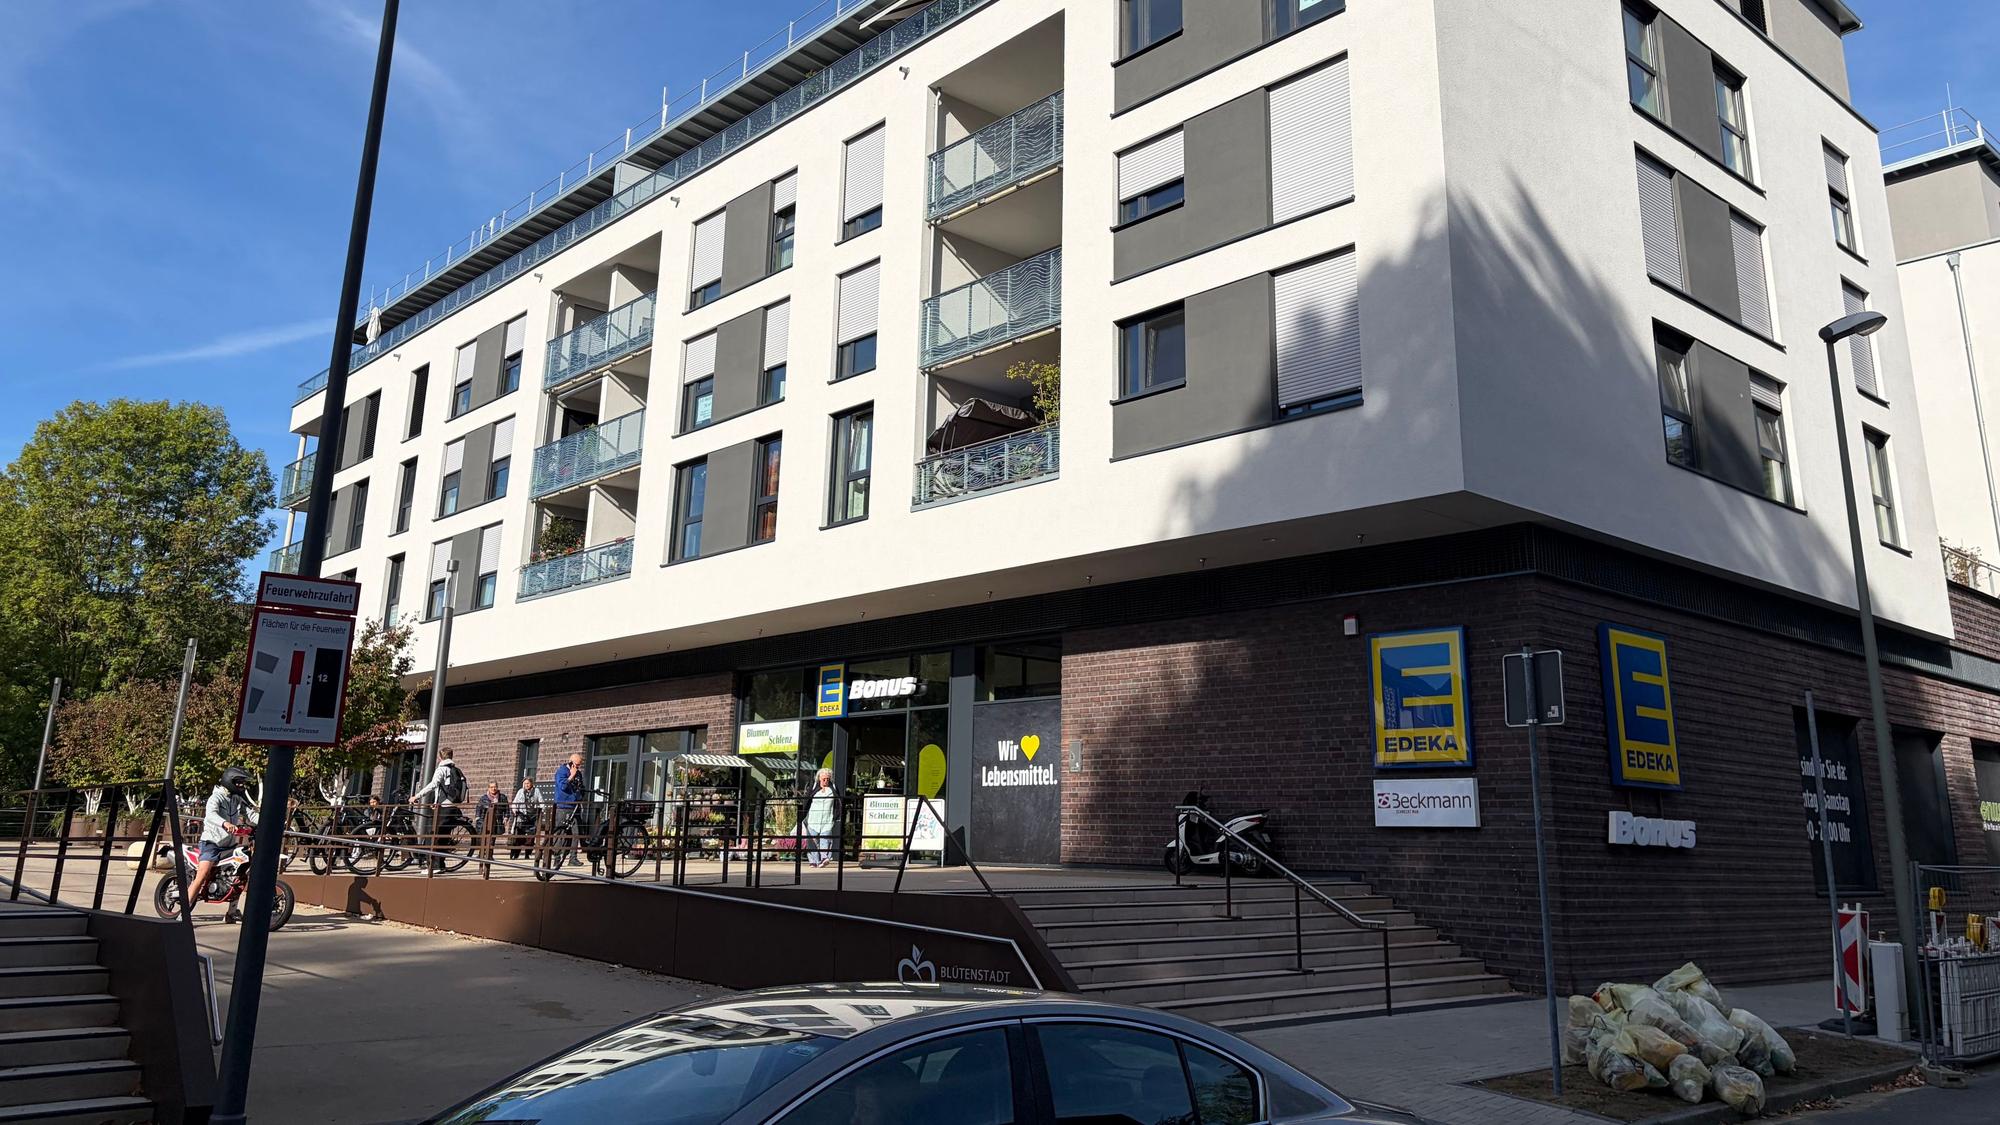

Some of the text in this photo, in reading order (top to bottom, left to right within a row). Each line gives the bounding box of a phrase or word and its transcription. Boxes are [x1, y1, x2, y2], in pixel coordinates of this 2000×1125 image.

[265, 583, 353, 604] Feuerwehrzufahrt
[261, 618, 347, 635] Flächen für die Feuerwehr
[317, 674, 329, 683] 12
[819, 703, 840, 713] EDEKA
[746, 728, 770, 738] Blumen
[768, 734, 793, 745] Schlenz
[997, 740, 1019, 761] Wir
[1384, 734, 1459, 753] EDEKA
[1626, 749, 1675, 773] EDEKA
[1825, 759, 1837, 779] Sie
[982, 763, 1058, 787] Lebensmittel.
[869, 799, 899, 809] Blumen
[1392, 792, 1472, 809] Beckmann
[869, 811, 899, 820] Schlenz
[940, 965, 1011, 984] BLÜTENSTADT
